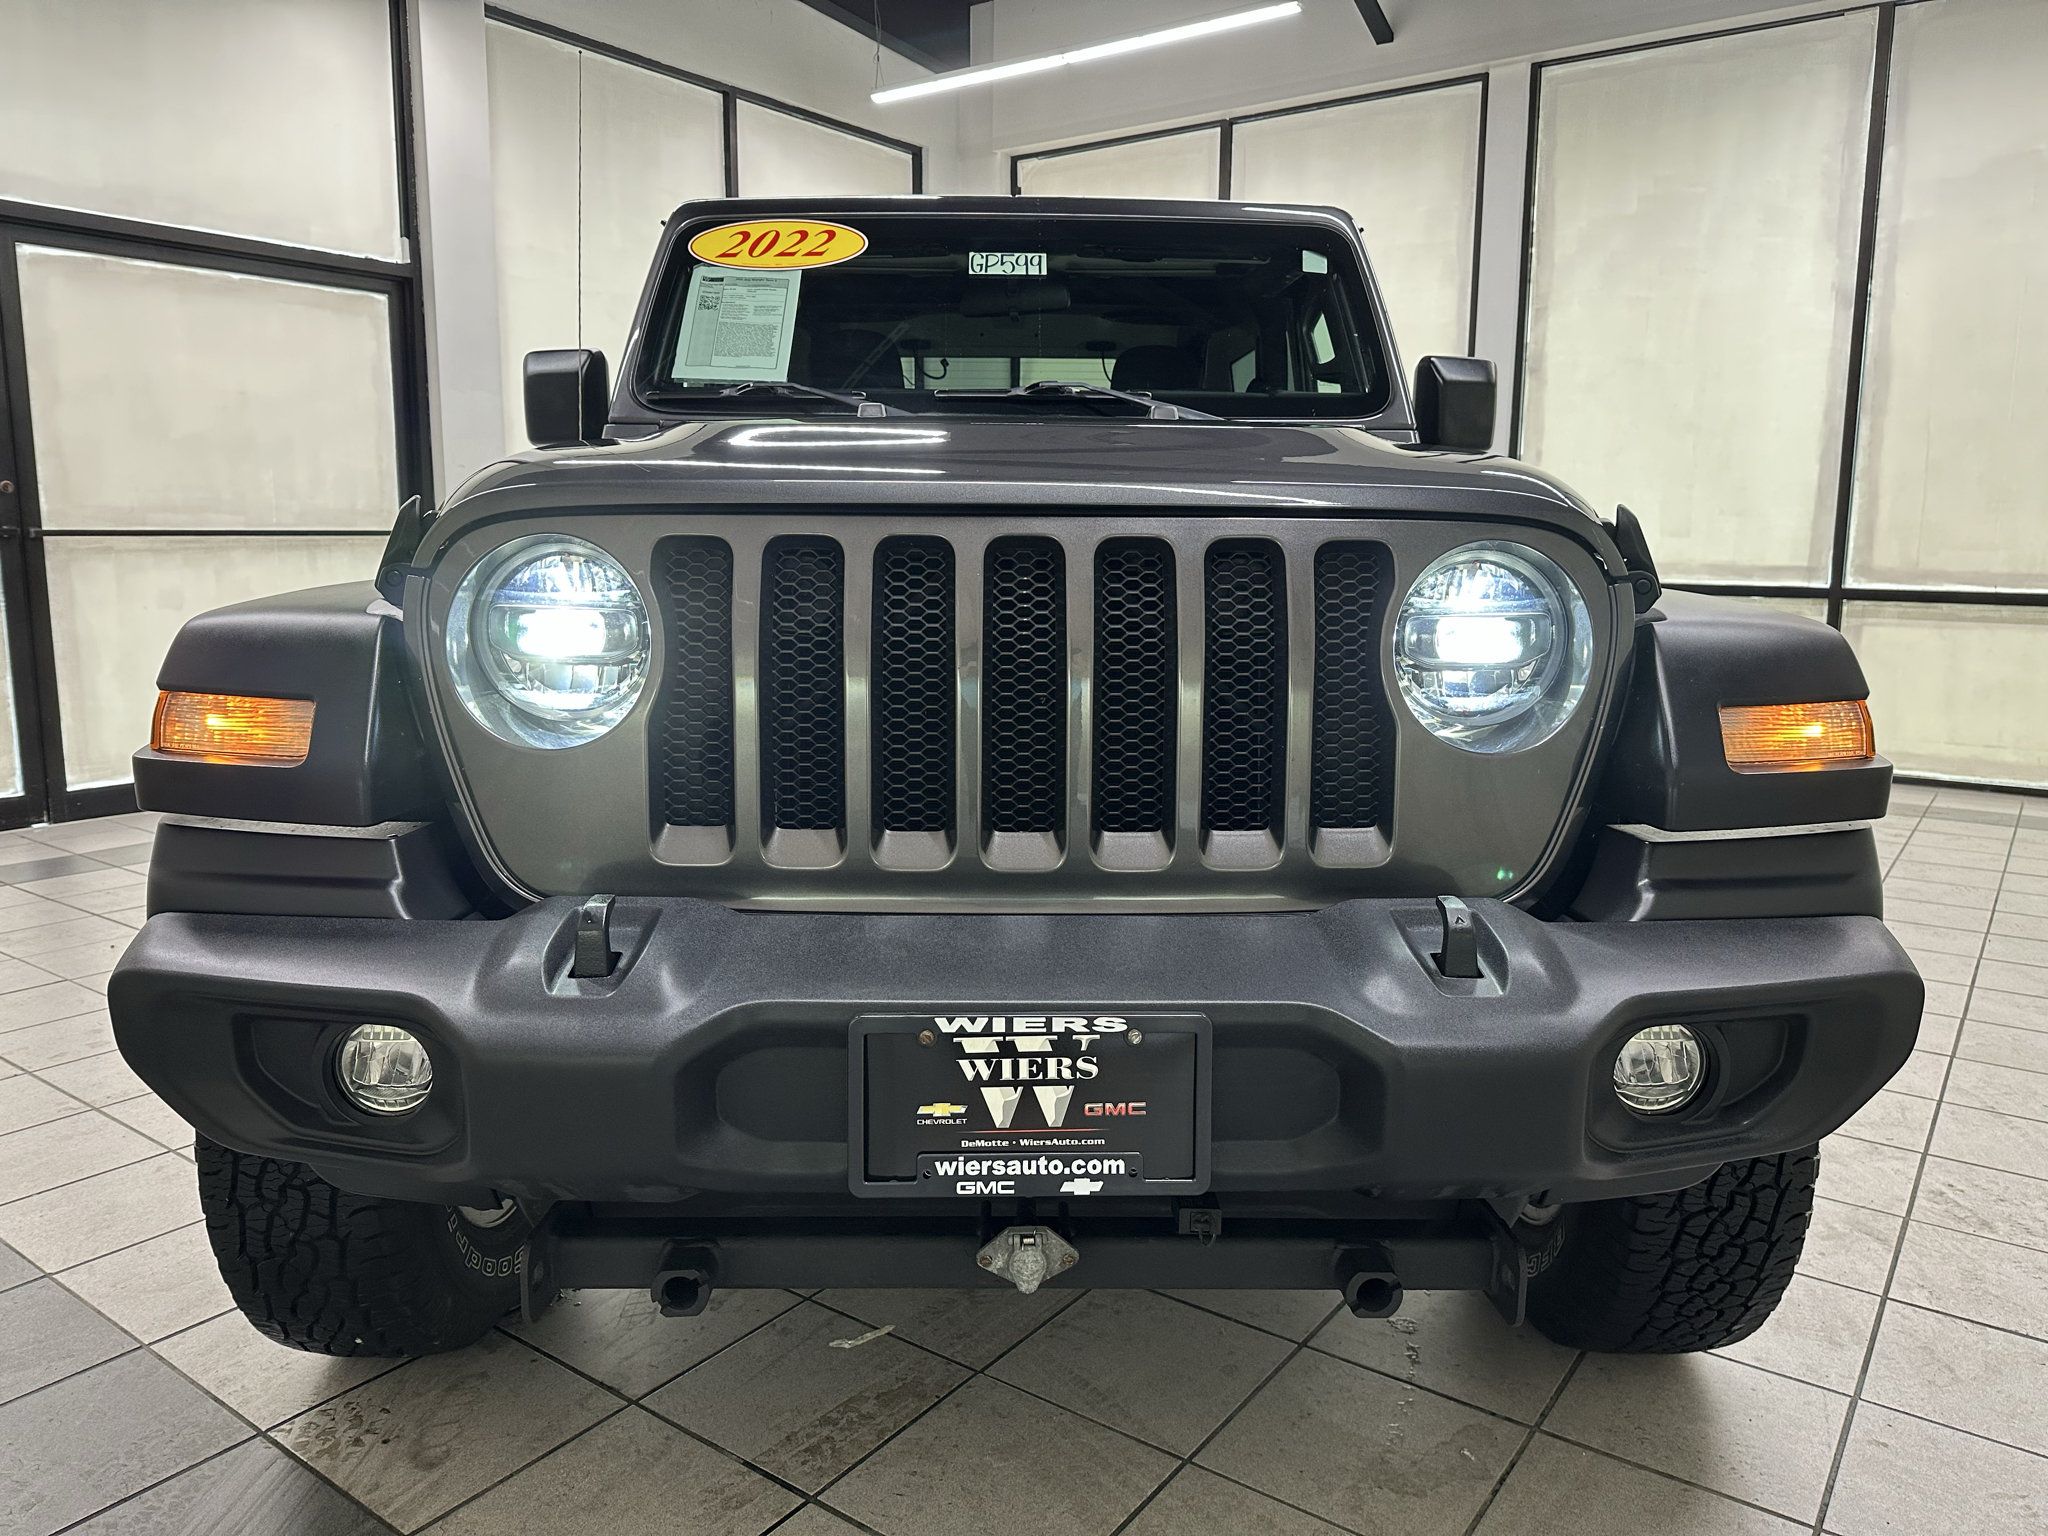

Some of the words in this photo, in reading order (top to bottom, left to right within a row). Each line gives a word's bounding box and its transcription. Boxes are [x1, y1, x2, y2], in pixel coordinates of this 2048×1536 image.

[714, 229, 837, 258] 2022
[970, 253, 1042, 275] GP599
[934, 1016, 1128, 1033] WIERS
[955, 1056, 1100, 1082] WIERS
[1083, 1101, 1147, 1117] GMC
[960, 1138, 1010, 1148] DeMotte
[1019, 1137, 1106, 1147] WiersAuto.com
[934, 1155, 1126, 1176] wiersauto.com
[955, 1180, 1015, 1195] GMC
